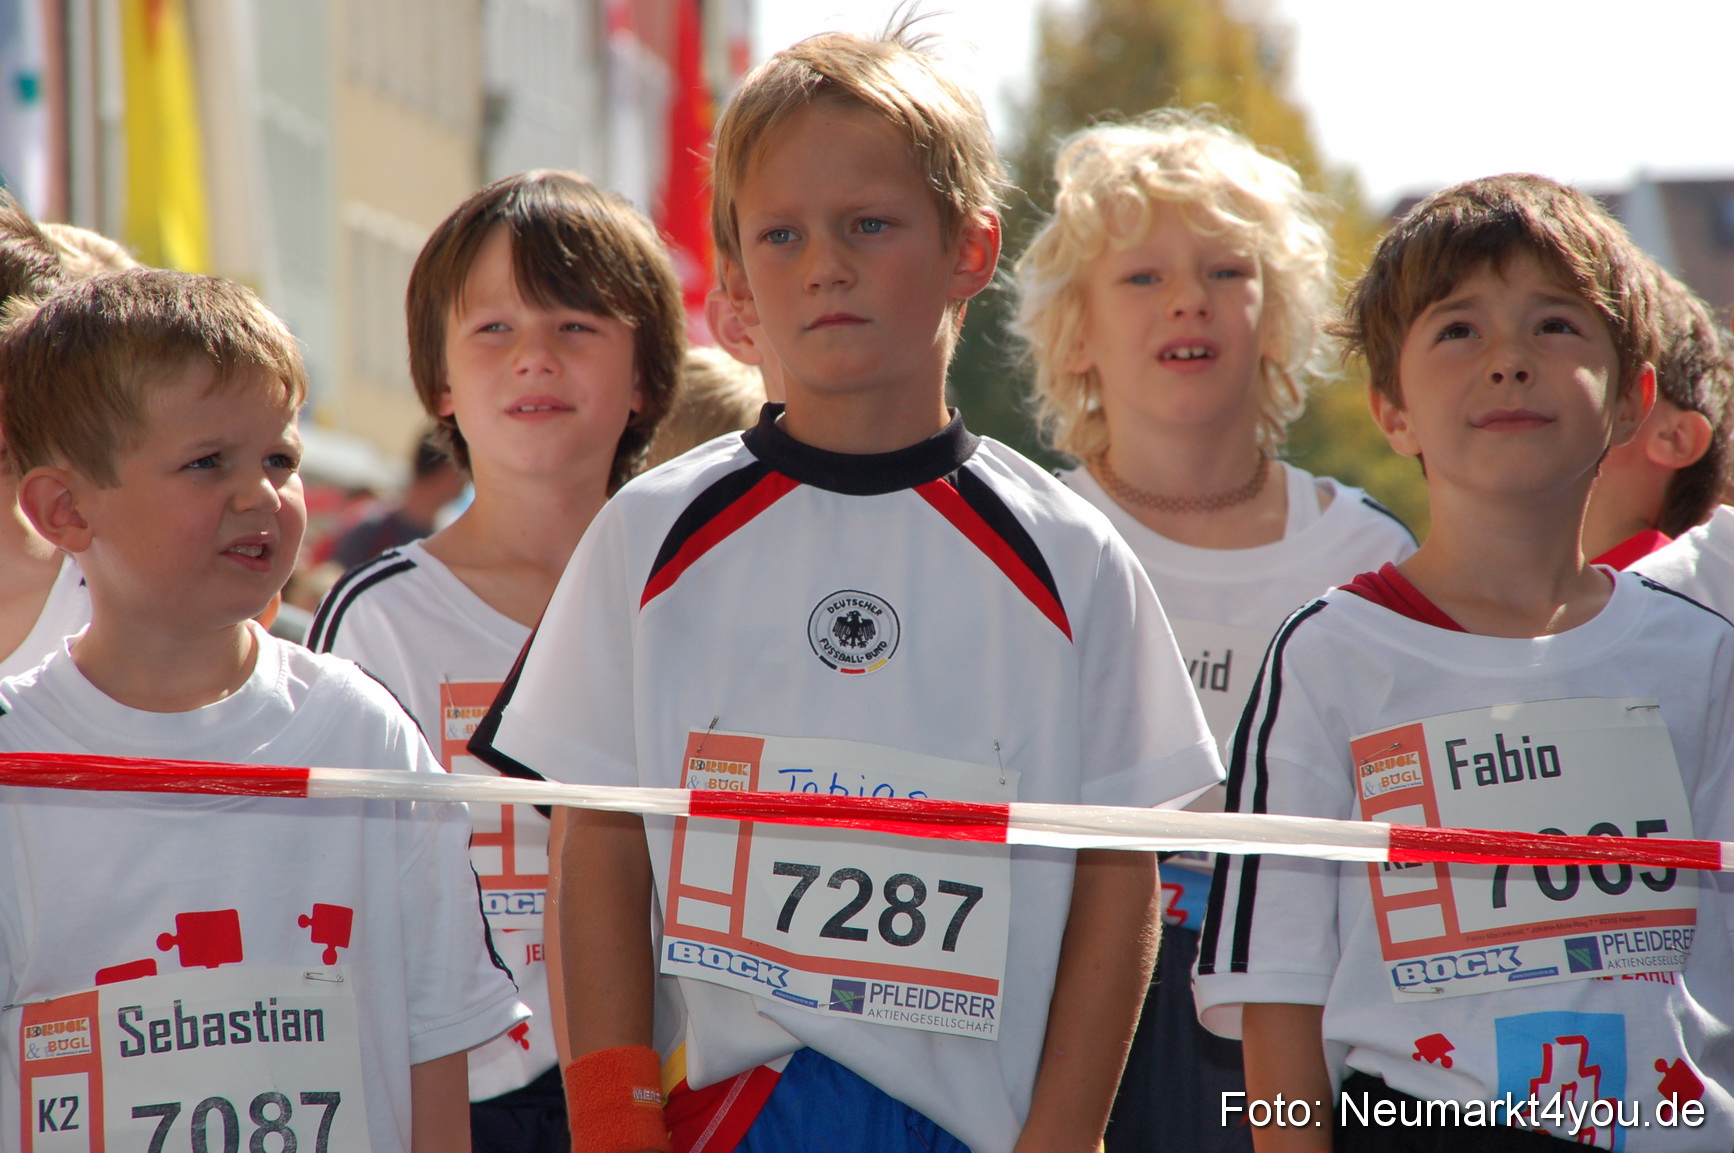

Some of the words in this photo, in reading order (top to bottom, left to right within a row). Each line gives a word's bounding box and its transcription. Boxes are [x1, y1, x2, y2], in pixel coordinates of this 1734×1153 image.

[827, 599, 883, 616] DEUTSCHER
[1381, 770, 1421, 788] BÖGL
[1445, 733, 1562, 790] Fabio
[772, 861, 984, 952] 7287
[668, 940, 789, 988] BOCK
[1391, 945, 1523, 987] BOCK
[867, 1008, 995, 1034] AKTIENGESELLSCHAFT
[869, 982, 995, 1020] PFLEIDERER
[47, 1036, 90, 1053] BÖGL
[118, 997, 325, 1058] Sebastian
[38, 1096, 79, 1132] K2
[131, 1091, 341, 1153] 7087
